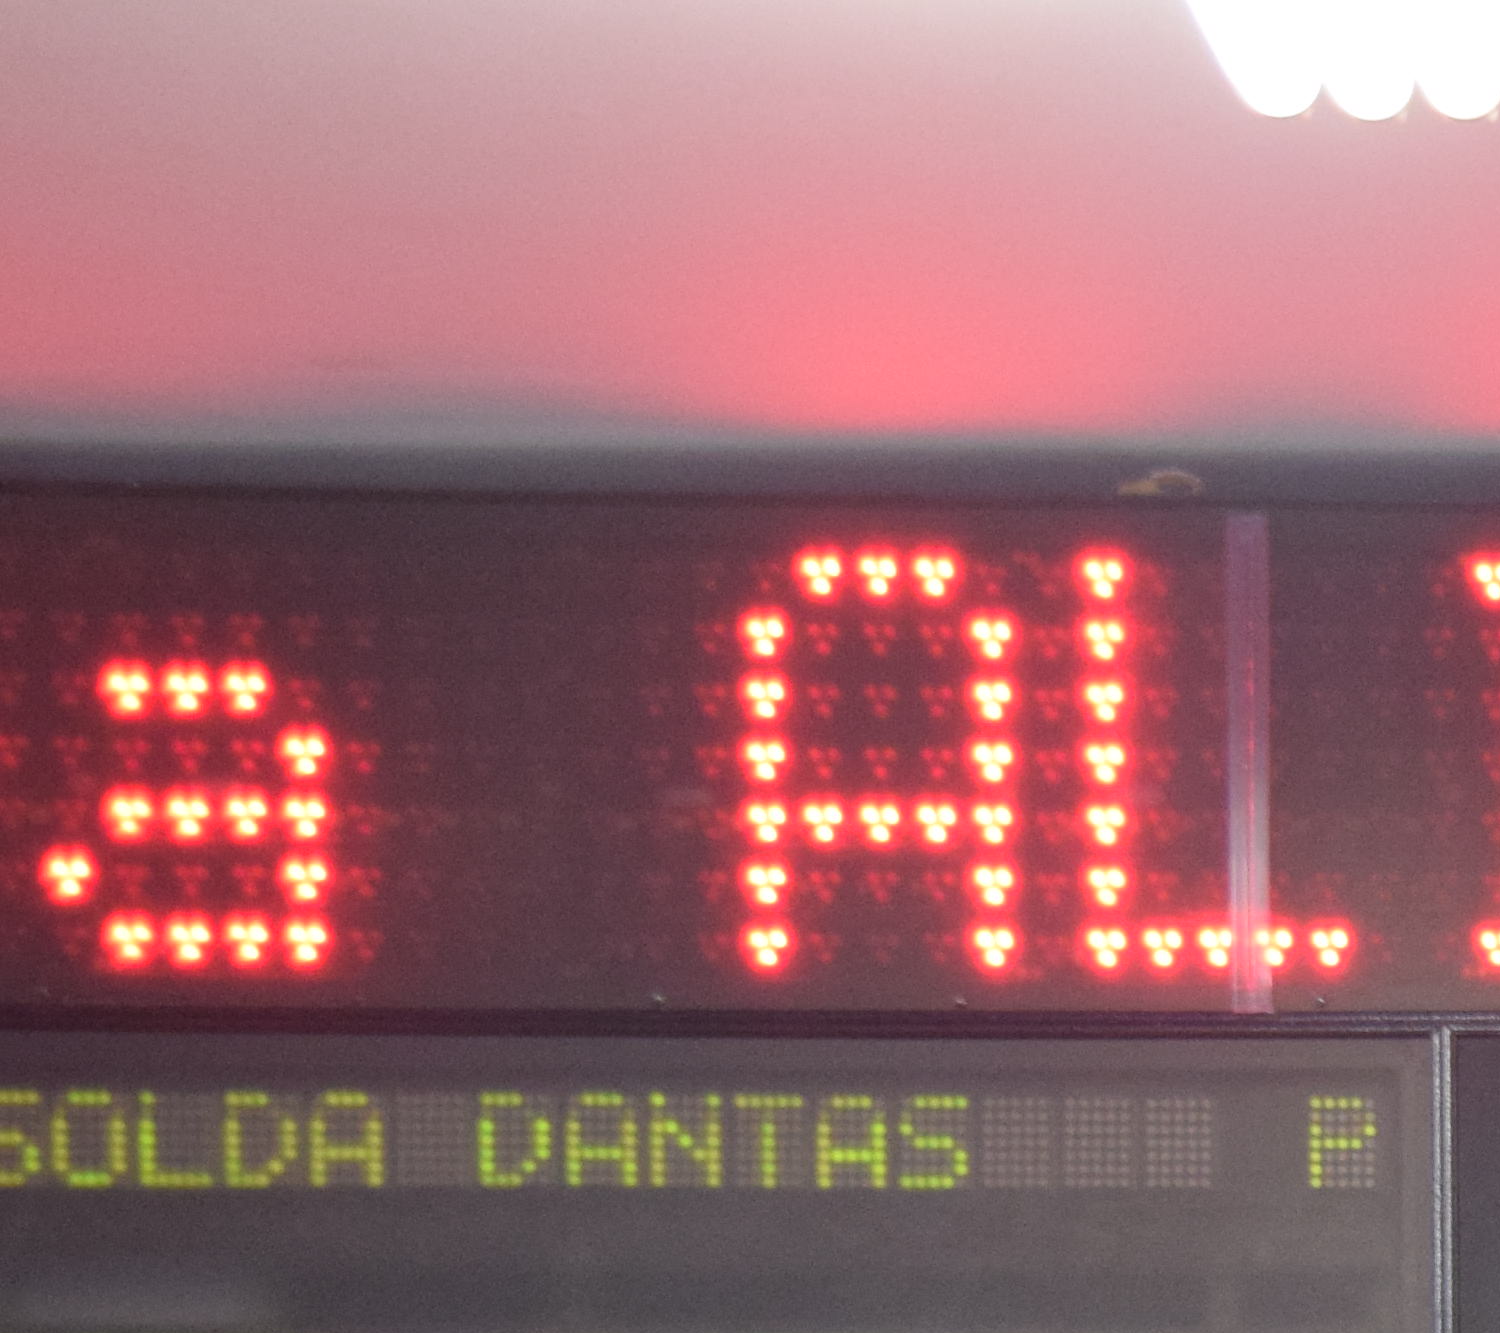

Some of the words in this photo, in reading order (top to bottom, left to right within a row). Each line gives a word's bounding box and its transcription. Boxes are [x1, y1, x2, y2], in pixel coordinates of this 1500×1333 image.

[38, 653, 337, 967] a
[476, 1092, 969, 1190] DANTAS
[1308, 1096, 1377, 1188] P
